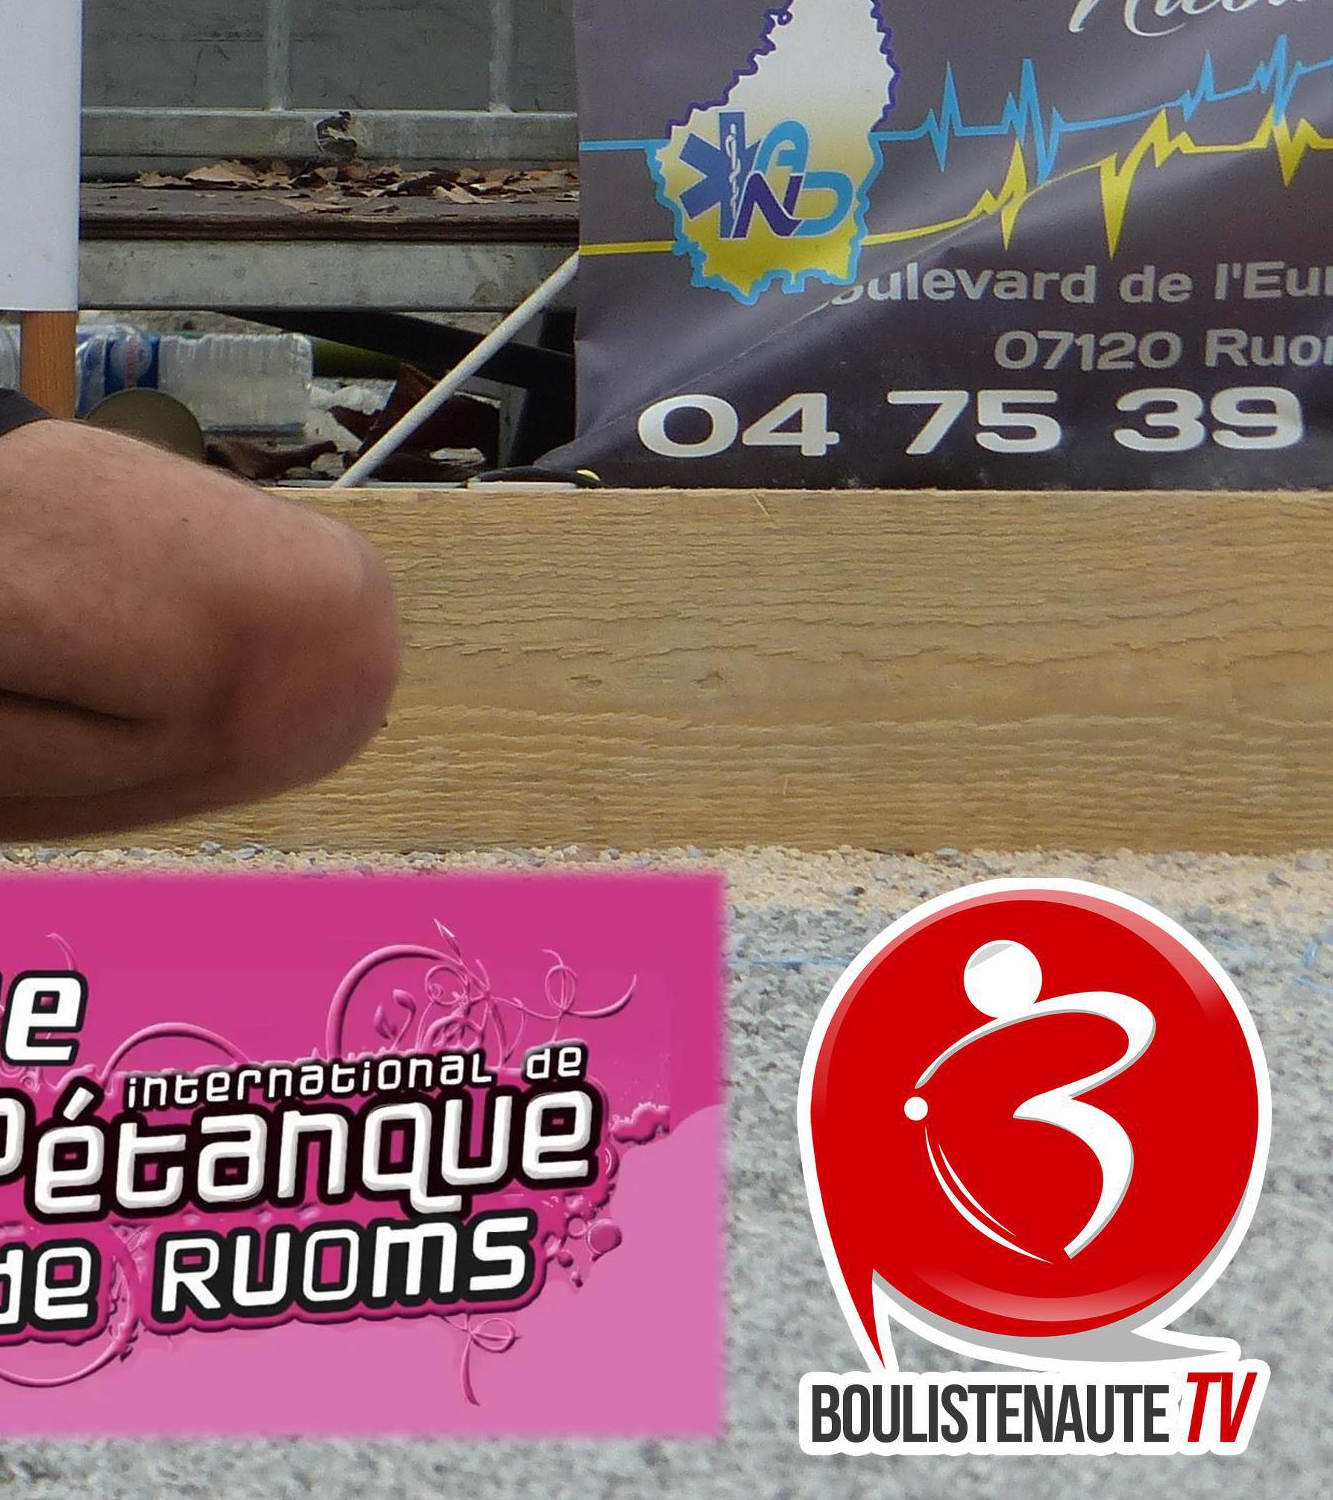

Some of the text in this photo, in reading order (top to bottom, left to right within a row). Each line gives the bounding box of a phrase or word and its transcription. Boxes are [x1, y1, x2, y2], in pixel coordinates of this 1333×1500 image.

[1119, 264, 1192, 305] de
[994, 327, 1333, 372] 07120 Ruo
[637, 386, 1305, 458] 04 75 39
